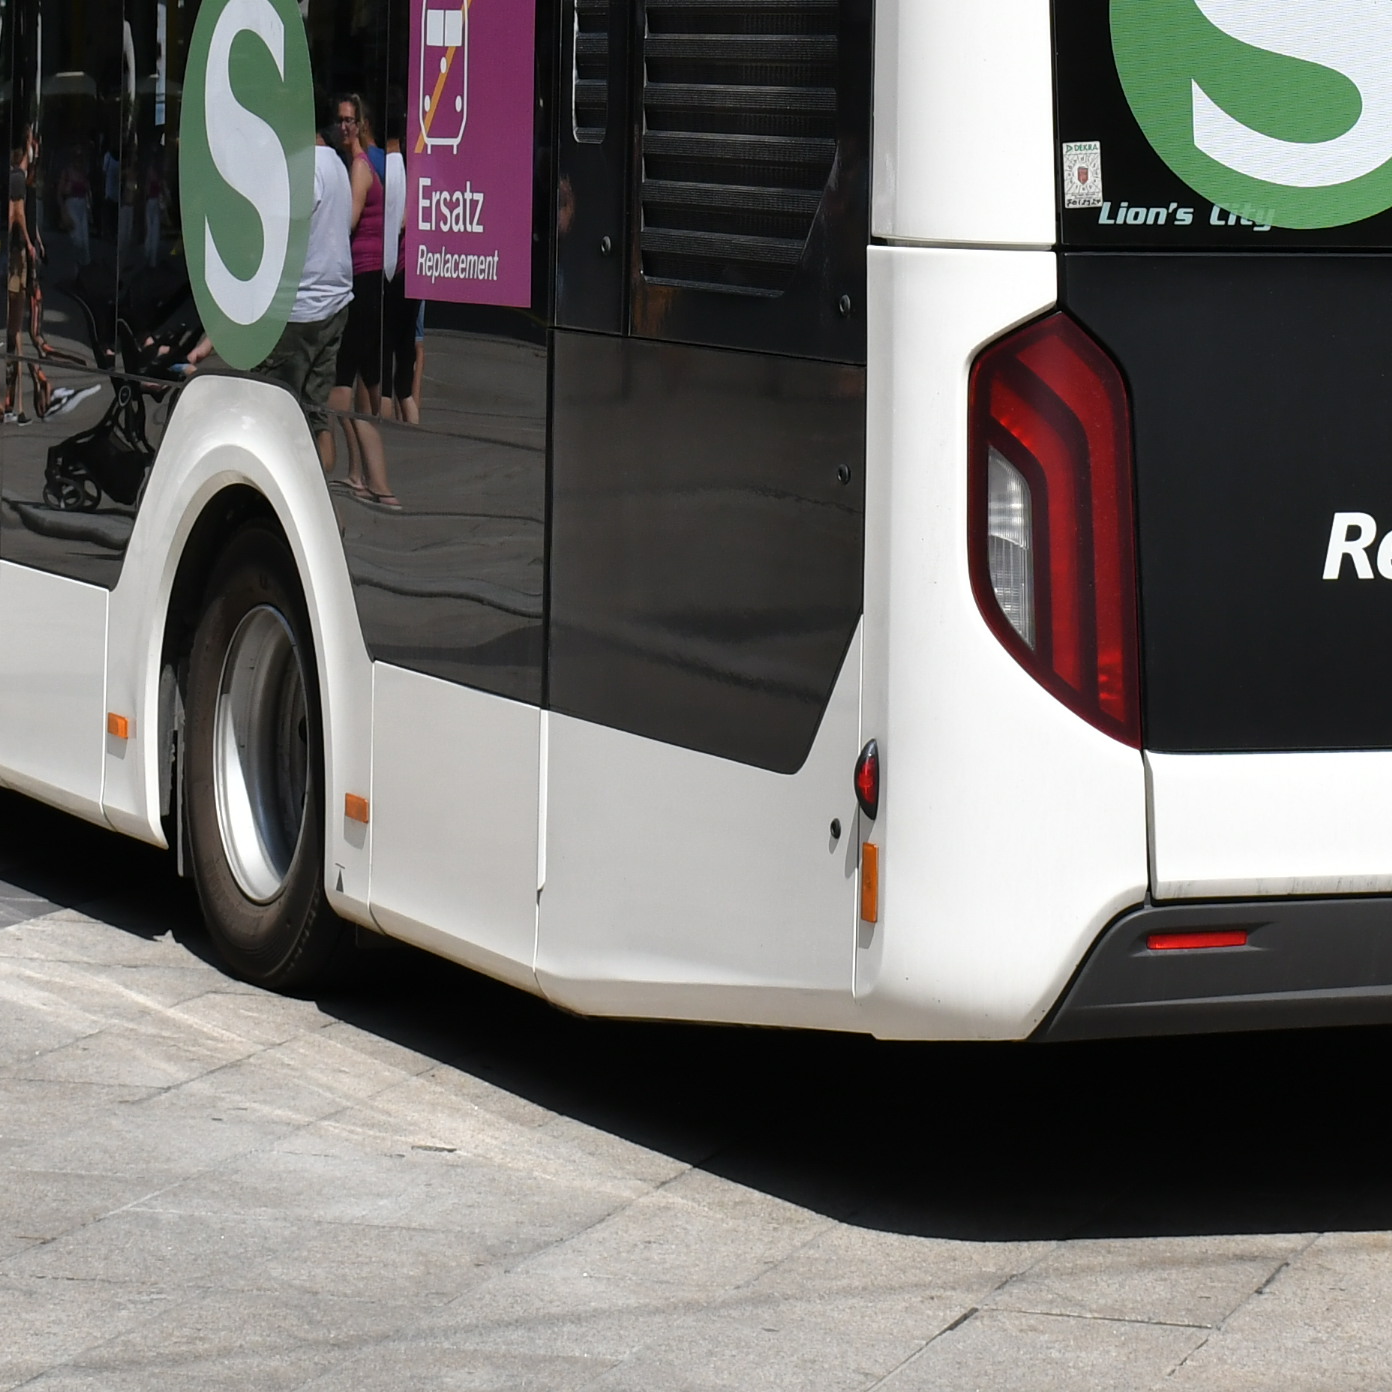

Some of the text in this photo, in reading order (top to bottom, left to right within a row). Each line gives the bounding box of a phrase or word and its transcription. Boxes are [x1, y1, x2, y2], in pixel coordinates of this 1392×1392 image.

[1074, 144, 1098, 152] DEKRA
[418, 177, 484, 233] Ersatz
[1098, 201, 1194, 225] Lion's
[416, 244, 499, 284] Replacement
